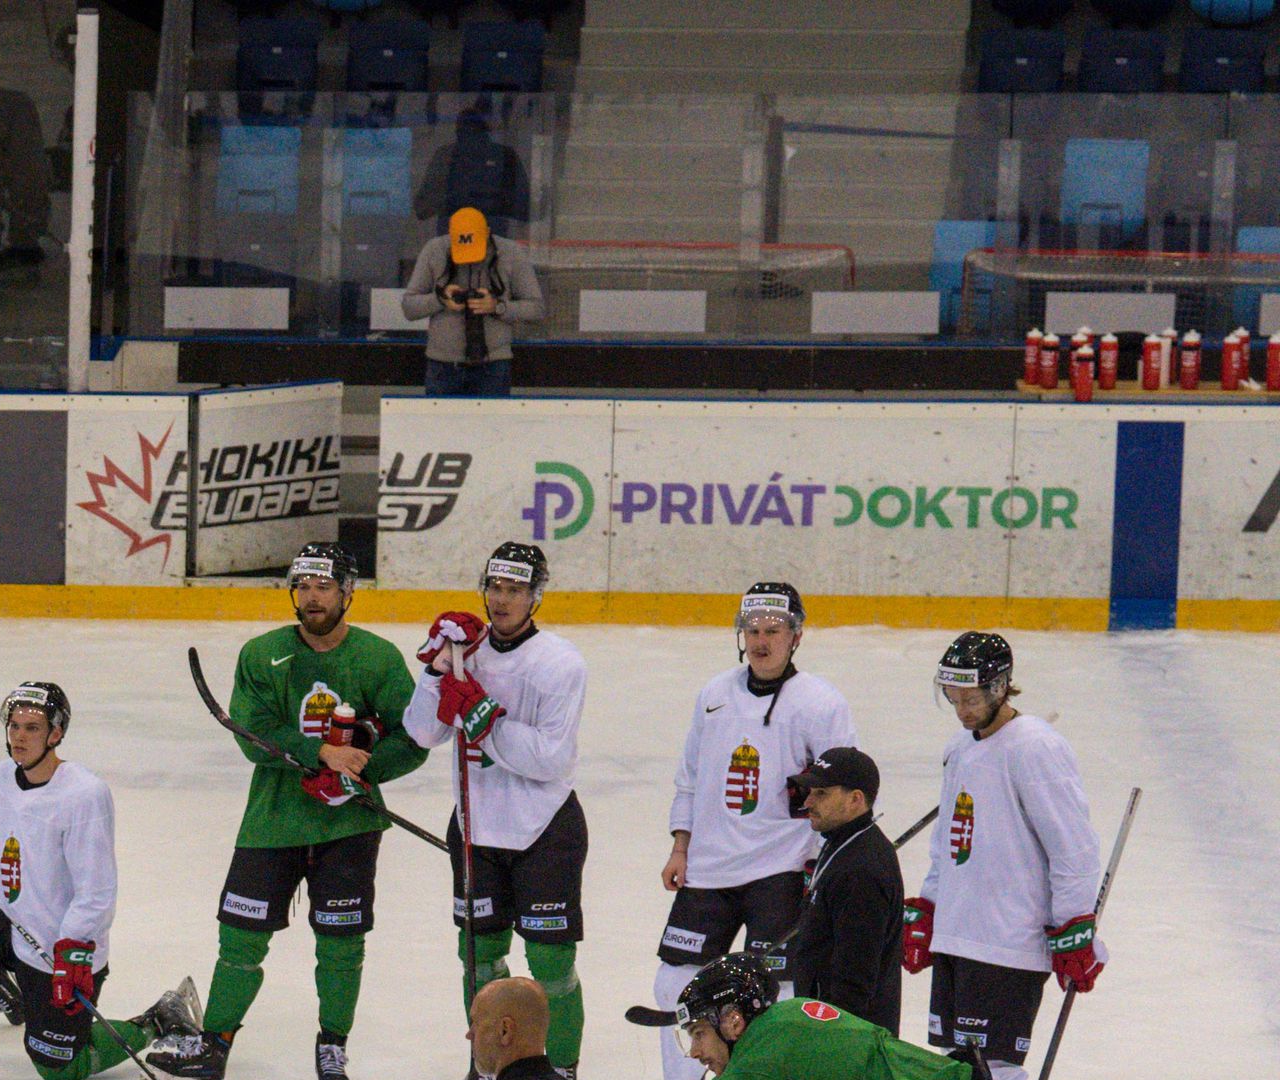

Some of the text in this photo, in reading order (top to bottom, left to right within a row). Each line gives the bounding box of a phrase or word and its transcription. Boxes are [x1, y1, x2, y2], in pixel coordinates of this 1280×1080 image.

[458, 234, 473, 243] M
[327, 898, 362, 907] CCM
[531, 902, 567, 911] CCM
[956, 1016, 989, 1027] CCM
[43, 1030, 77, 1043] CCM
